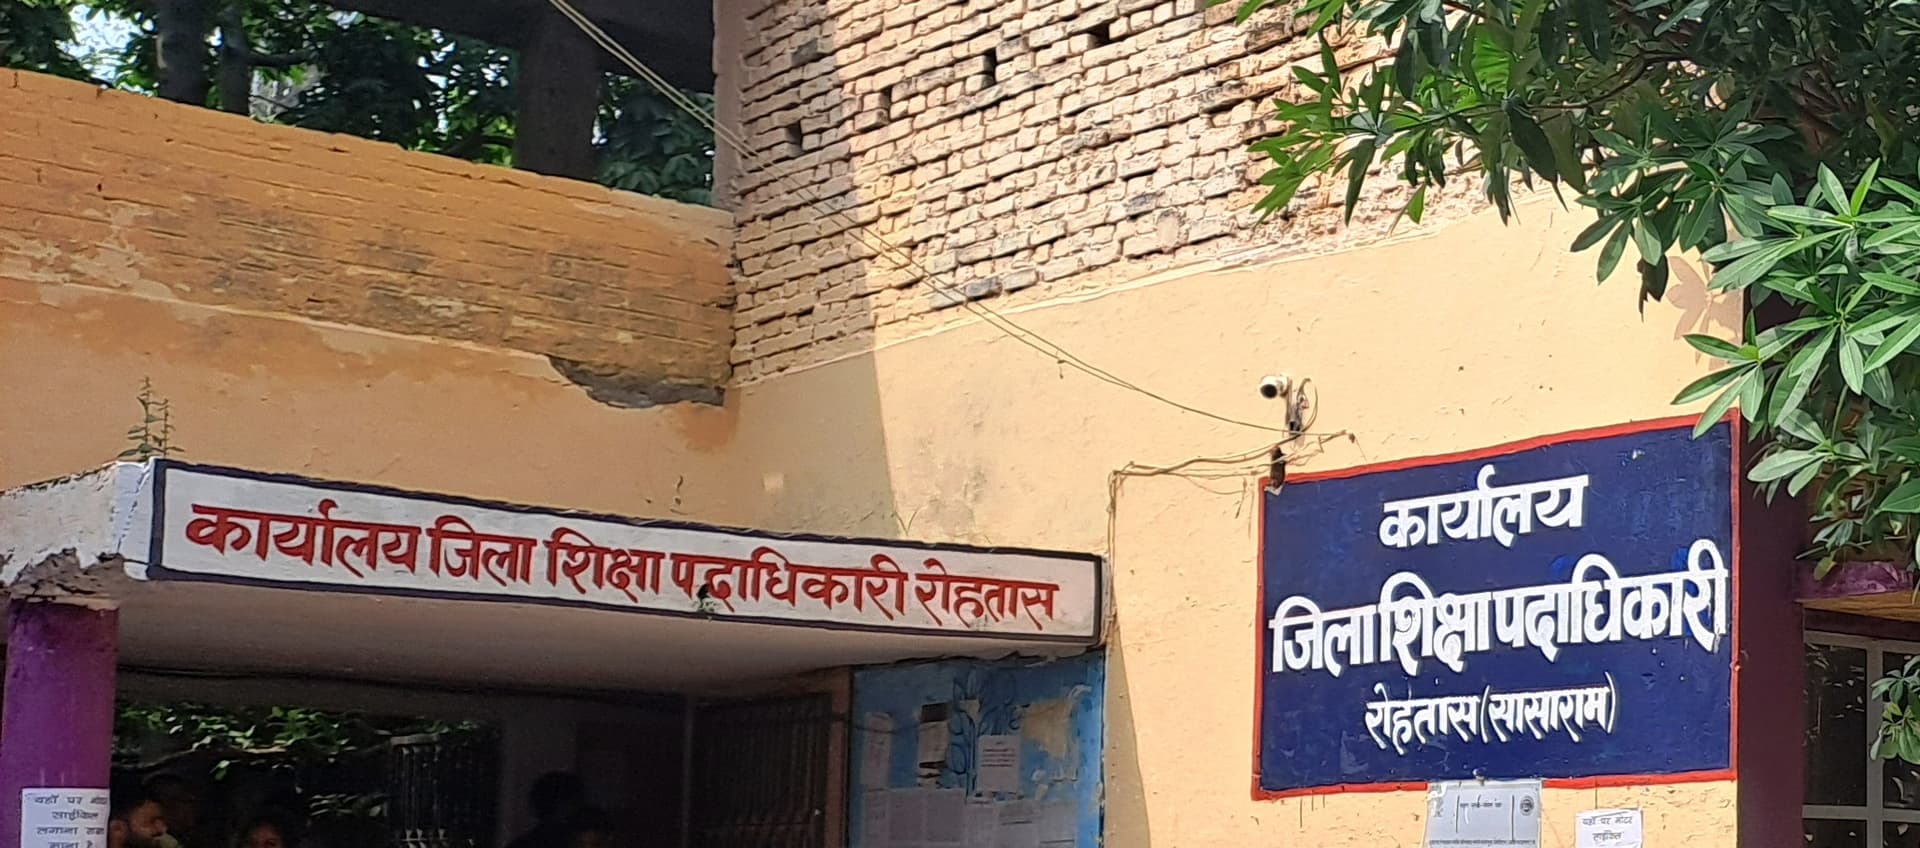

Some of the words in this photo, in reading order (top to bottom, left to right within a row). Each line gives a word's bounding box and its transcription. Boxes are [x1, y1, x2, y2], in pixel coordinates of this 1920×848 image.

[186, 498, 421, 578] कार्यालय
[426, 515, 537, 587] जिला
[543, 527, 665, 602] शिक्षा
[670, 546, 908, 621] पदाधिकारी
[915, 558, 1060, 631] रोहतास
[1379, 464, 1589, 548] कार्यालय
[1269, 595, 1378, 676] जिला
[1377, 571, 1493, 676] शिक्षा
[1491, 538, 1729, 662] पदाधिकारी
